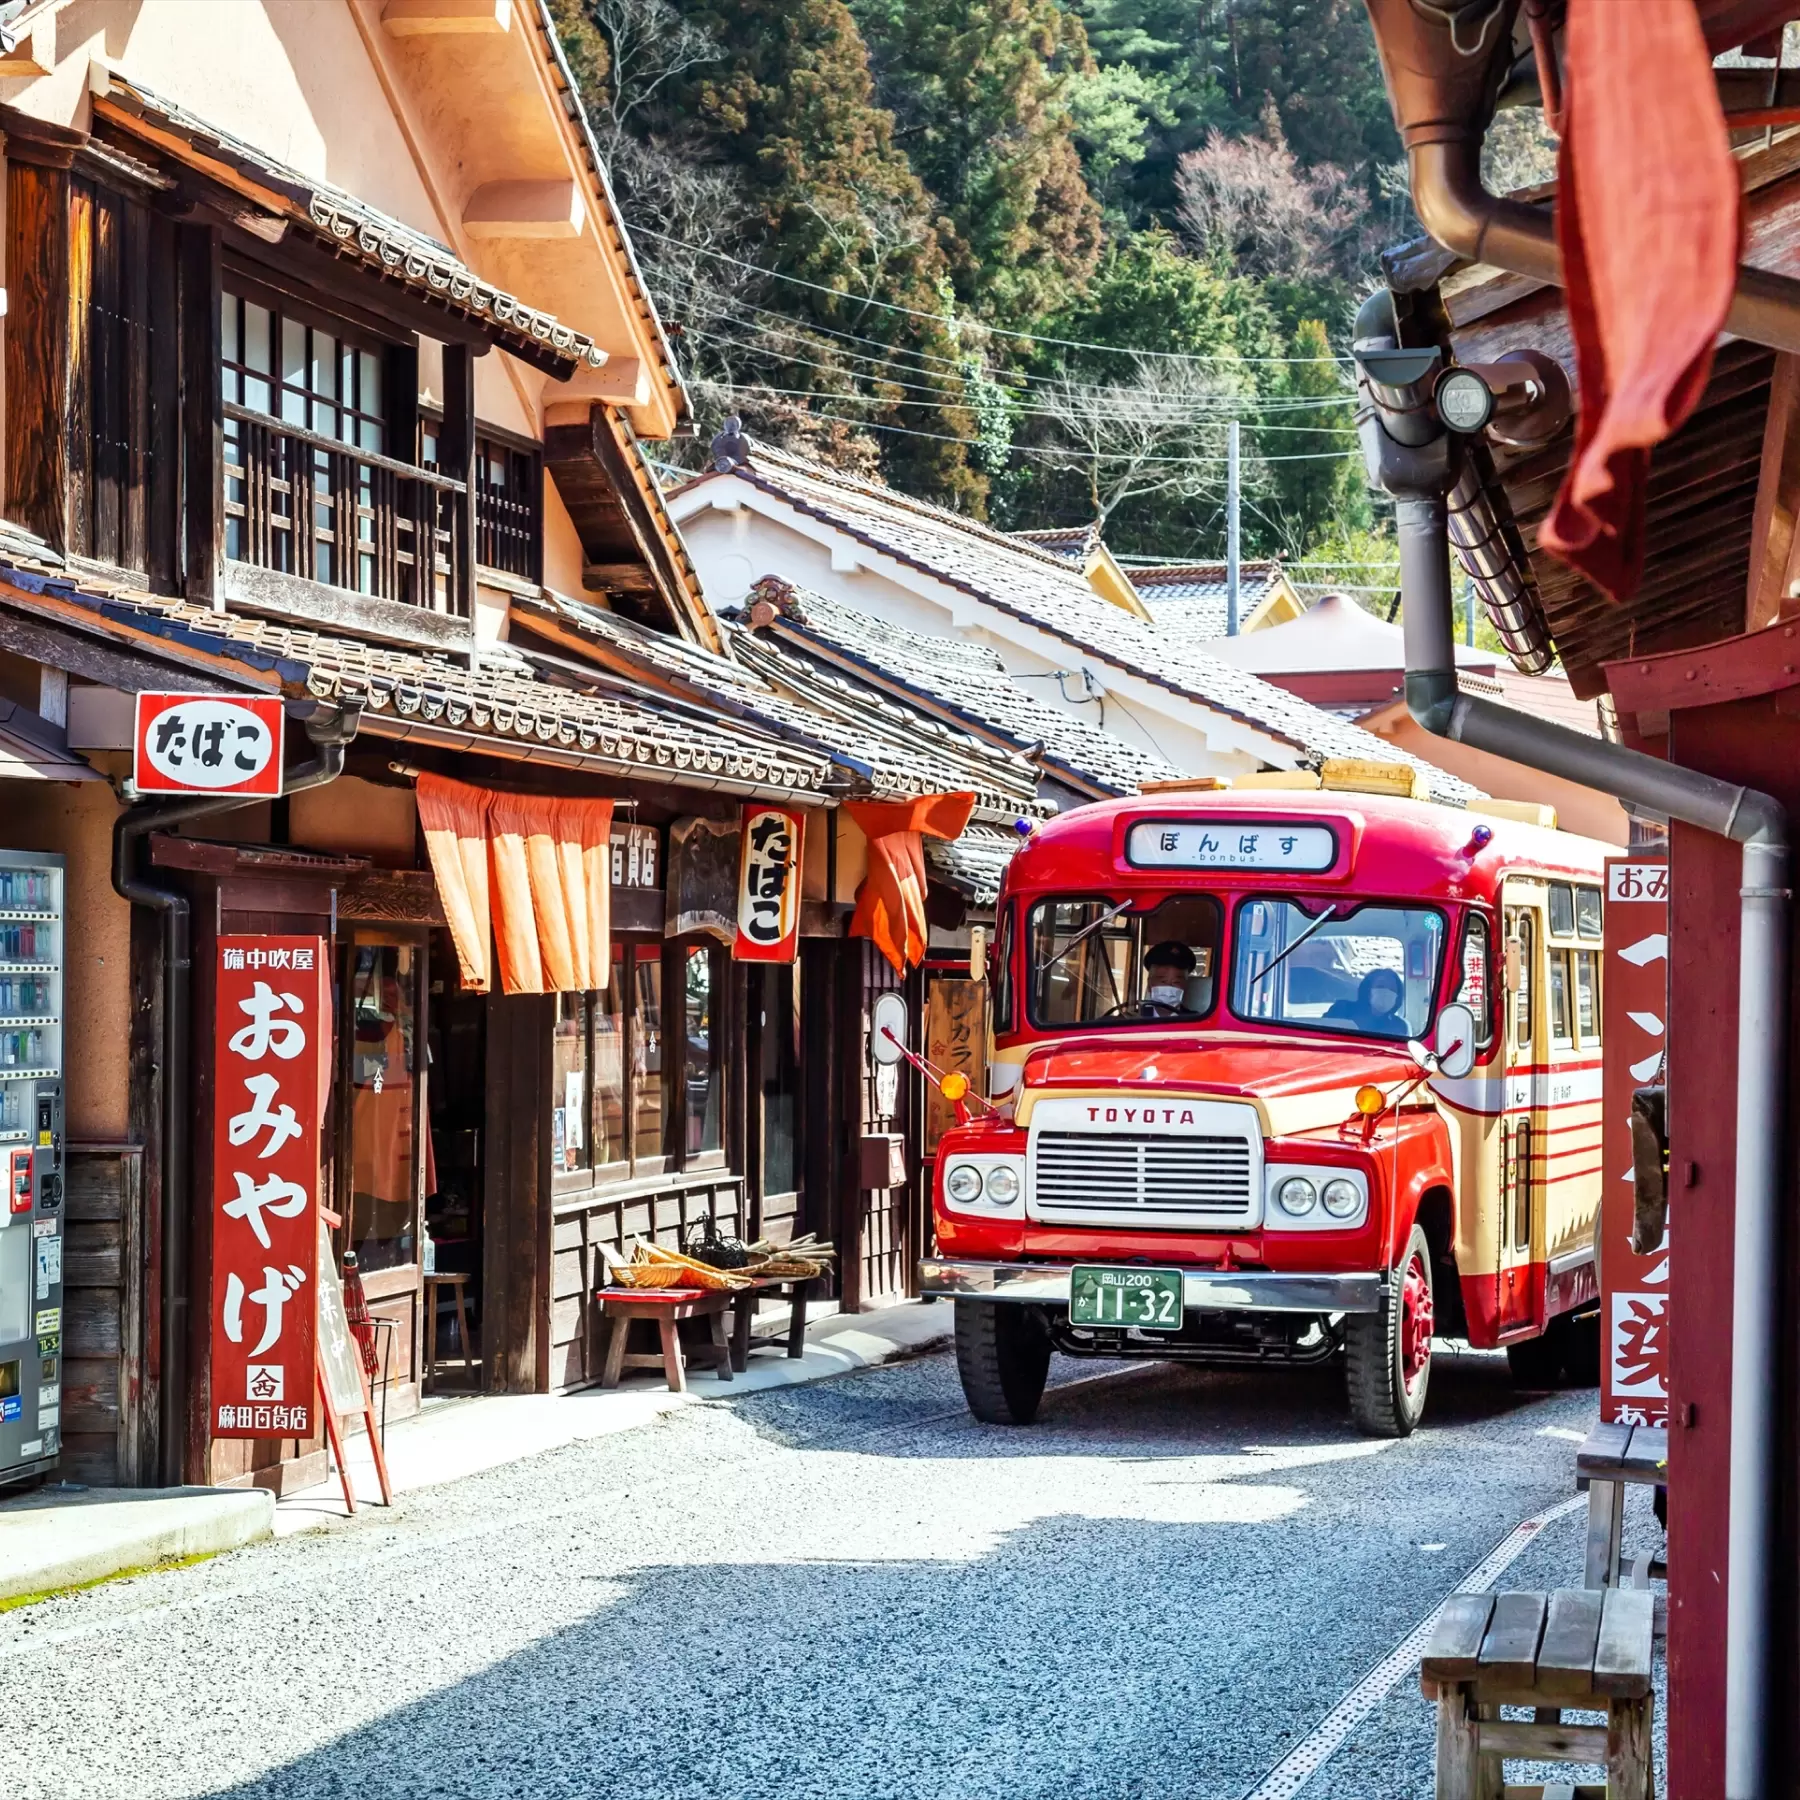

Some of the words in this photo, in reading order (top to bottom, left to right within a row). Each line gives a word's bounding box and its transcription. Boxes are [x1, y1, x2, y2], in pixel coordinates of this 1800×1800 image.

[156, 715, 260, 771] たばこ
[610, 827, 657, 888] 百貨店
[1160, 832, 1298, 855] ぼんばす
[748, 816, 796, 940] たばこ
[222, 948, 315, 970] 備中吹屋
[1086, 1107, 1194, 1124] TOYOTA
[222, 980, 308, 1358] おみやげ
[1096, 1287, 1175, 1323] 11-32
[218, 1404, 307, 1431] 麻田百貨店
